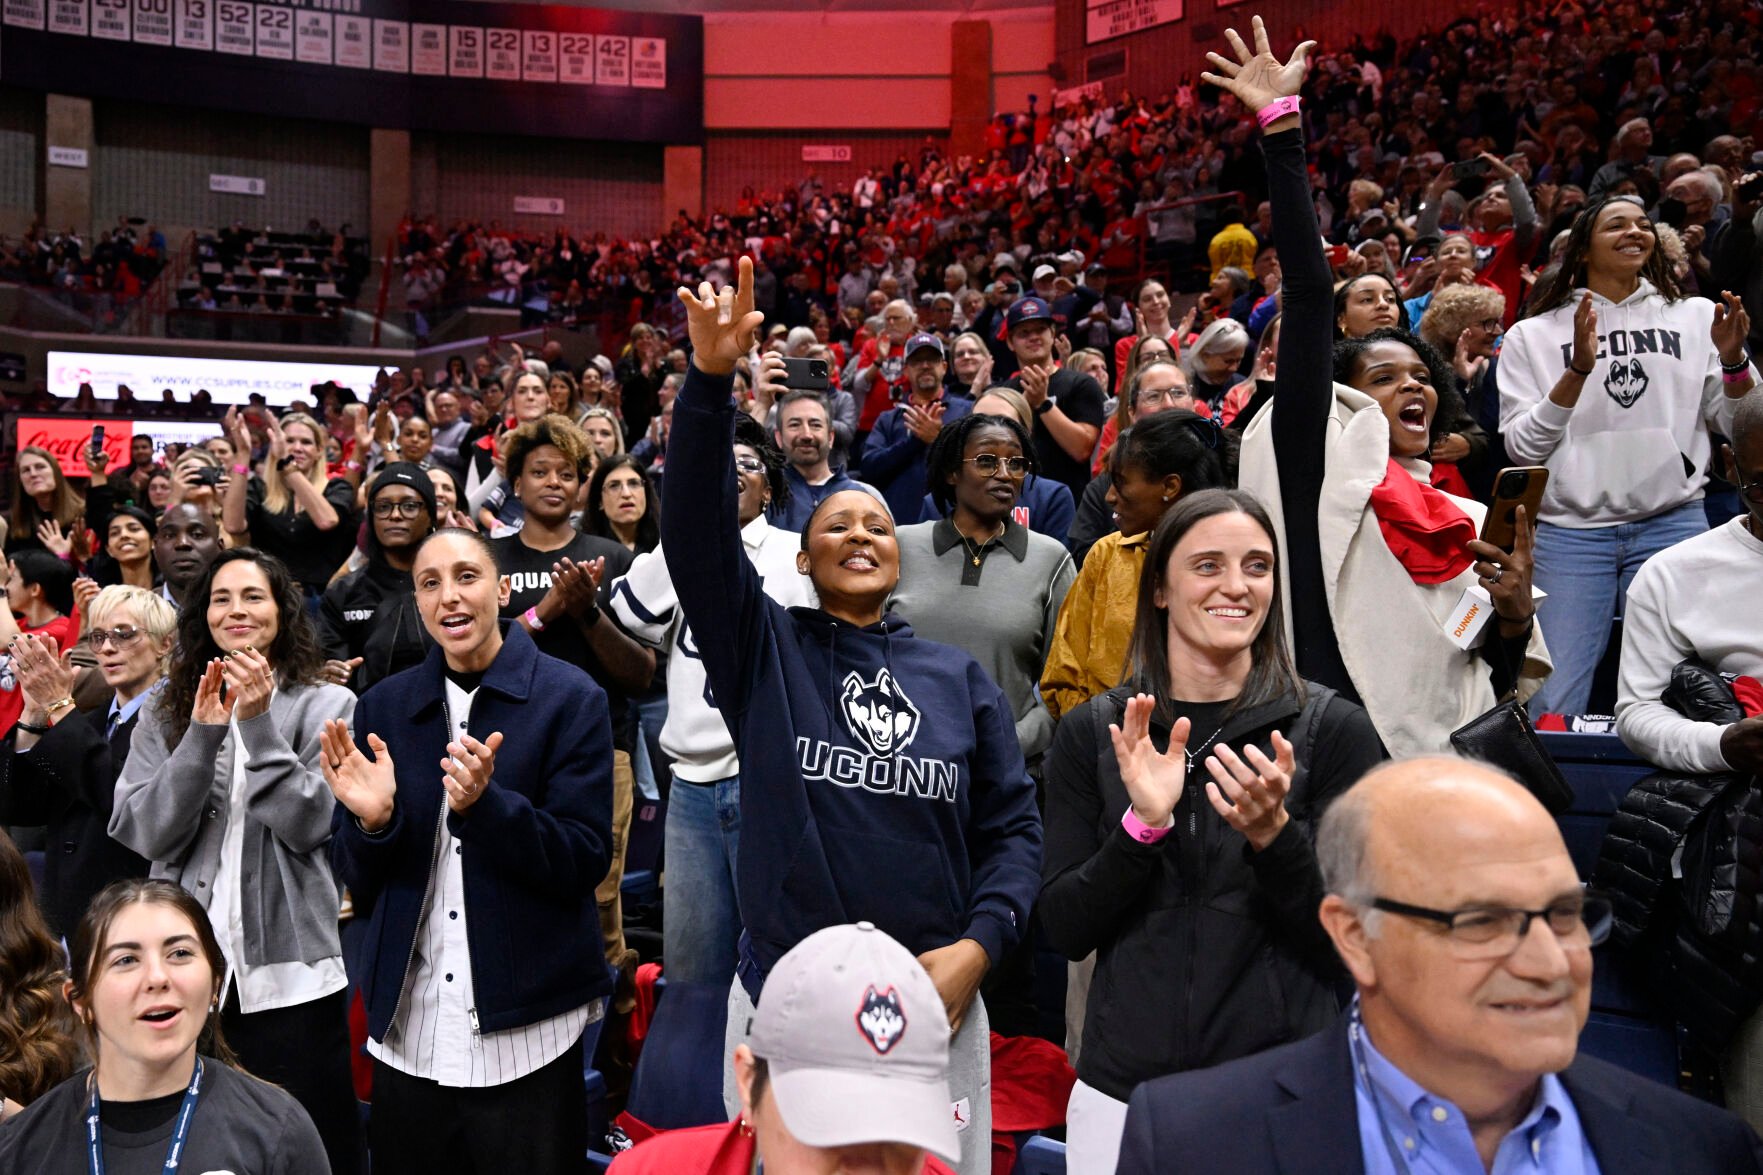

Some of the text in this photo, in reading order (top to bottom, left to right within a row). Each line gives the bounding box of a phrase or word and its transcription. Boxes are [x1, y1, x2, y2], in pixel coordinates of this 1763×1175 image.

[184, 0, 206, 19] 13
[220, 4, 250, 24] 52
[260, 9, 289, 29] 22
[457, 30, 477, 48] 15
[489, 32, 517, 50] 22
[531, 35, 550, 53] 13
[563, 37, 590, 55] 22
[600, 40, 626, 57] 42
[832, 148, 848, 159] 10
[343, 609, 375, 621] UCON
[1453, 603, 1480, 638] DUNKIN'
[796, 736, 958, 803] UCONN
